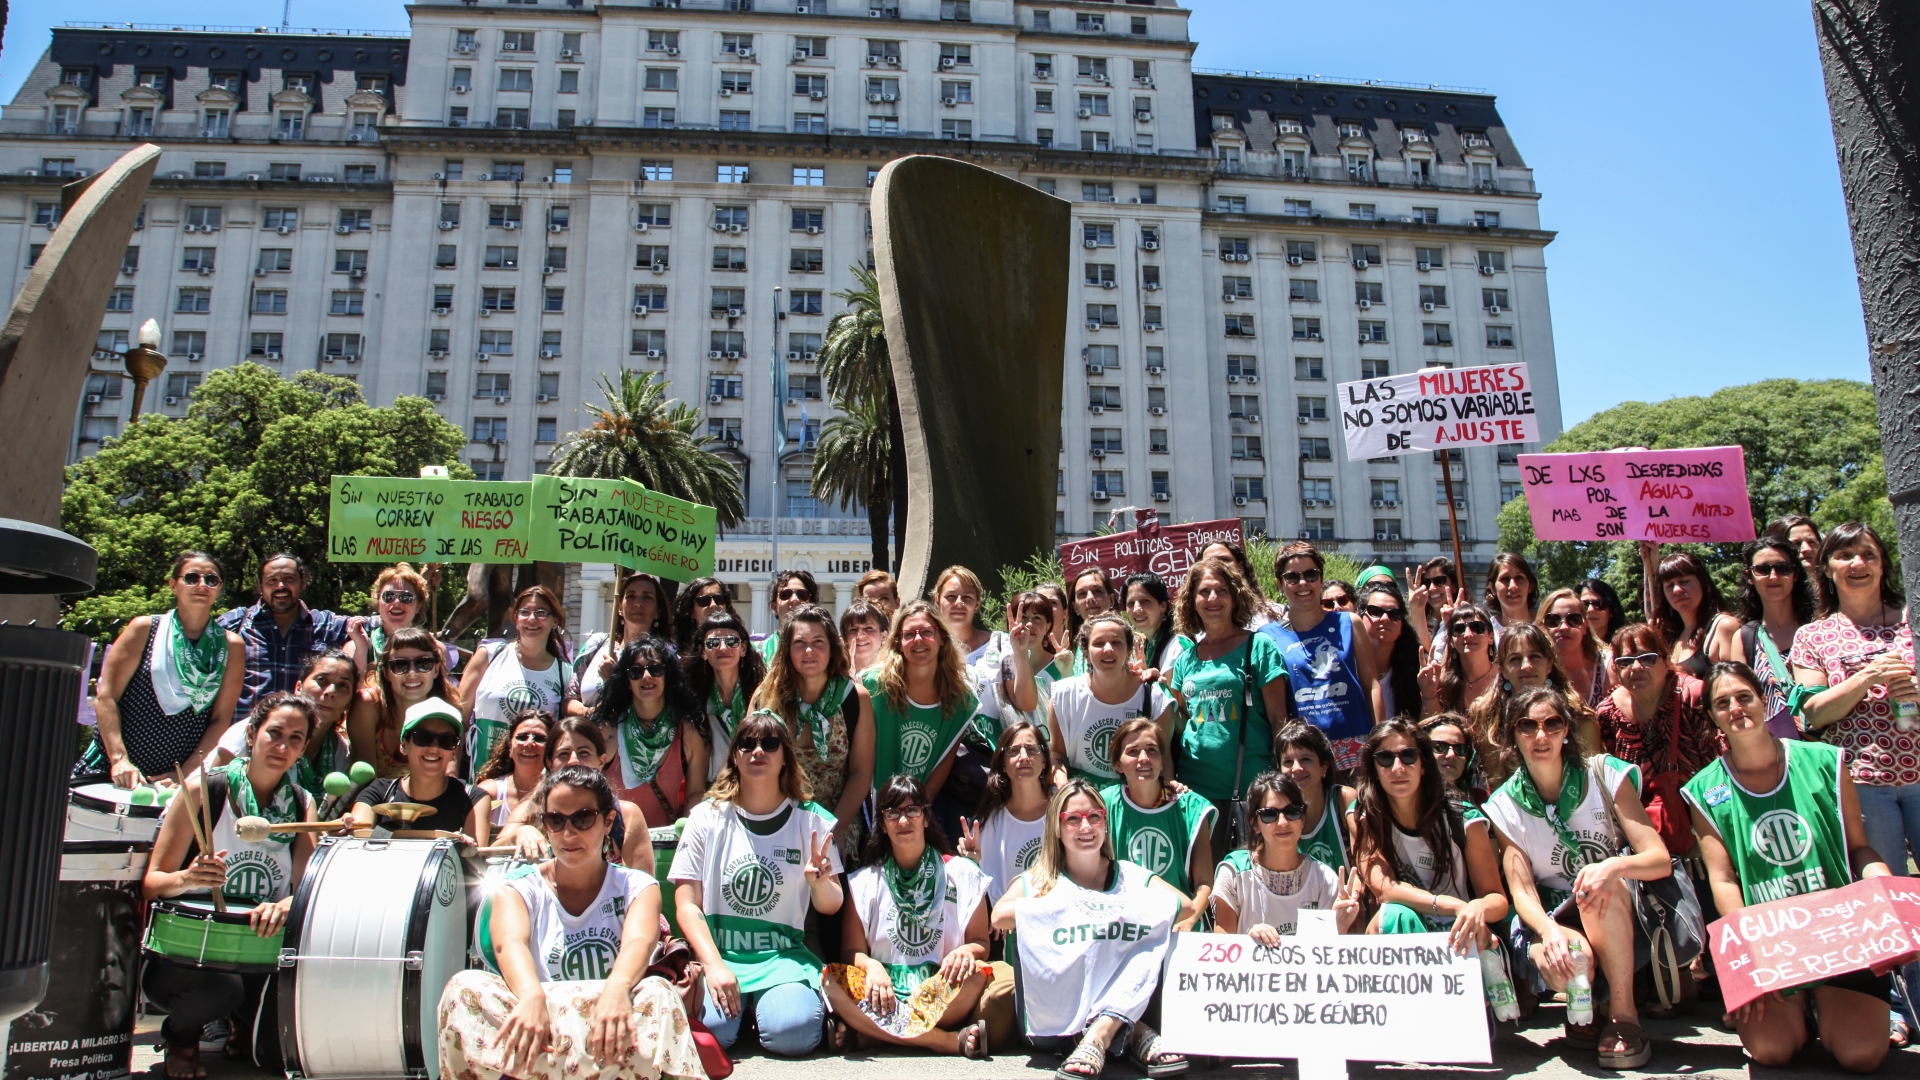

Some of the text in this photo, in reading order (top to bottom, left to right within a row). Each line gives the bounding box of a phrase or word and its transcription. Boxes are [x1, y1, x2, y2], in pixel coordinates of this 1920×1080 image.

[1348, 366, 1525, 406] LAS MUJERES
[1344, 408, 1374, 431] NO
[1381, 398, 1448, 425] SOMOS
[1386, 419, 1526, 451] DE AJUSTE
[1525, 465, 1553, 485] DE
[1569, 465, 1605, 483] LXS
[376, 491, 444, 506] NUESTRO
[464, 492, 524, 507] TRABAJO
[1586, 480, 1694, 503] POR AGUAD
[559, 483, 696, 525] SIN MUJERES
[1552, 508, 1582, 522] MAS
[1605, 506, 1627, 520] DE
[1648, 505, 1669, 518] LA
[375, 508, 435, 528] CORREN
[547, 504, 707, 554] TRABAJANDO NO HAY
[1595, 521, 1711, 538] SON MUJERES
[332, 535, 357, 556] LAS
[366, 537, 427, 556] MUJERES
[435, 538, 456, 555] DE
[460, 538, 482, 555] LAS
[1110, 566, 1127, 580] DE
[1198, 688, 1232, 703] Mujeres
[1084, 718, 1113, 741] FORTALECER
[1583, 830, 1591, 839] EL
[1757, 814, 1806, 861] ATE
[1132, 831, 1169, 872] ATE
[254, 851, 262, 861] EL
[264, 854, 283, 881] ESTADO
[723, 854, 784, 886] FORTALECER EL ESTADO
[226, 867, 266, 895] ATE
[736, 866, 770, 902] ATE
[722, 884, 781, 917] PARA LIBERAR LA NACION
[589, 927, 598, 937] EL
[1053, 922, 1151, 945] CITEDEF
[1720, 907, 1812, 954] AGUAD
[1817, 899, 1866, 919] DEJA
[1873, 894, 1885, 903] A
[896, 941, 919, 957] LIBERAR
[921, 947, 929, 956] LA
[1198, 943, 1452, 966] 250 CASOS SE ENCUENTRAN
[1728, 953, 1751, 971] DE
[1761, 941, 1797, 957] LAS
[567, 944, 613, 980] ATE
[1179, 972, 1465, 996] EN TRAMITE EN LA DIRECCION DE
[1204, 1000, 1387, 1026] POLITICAS DE GÉNERO
[9, 1039, 68, 1055] ¡LIBERTAD
[71, 1040, 79, 1050] A
[81, 1035, 118, 1048] MILAGRO
[50, 1058, 79, 1068] Presa
